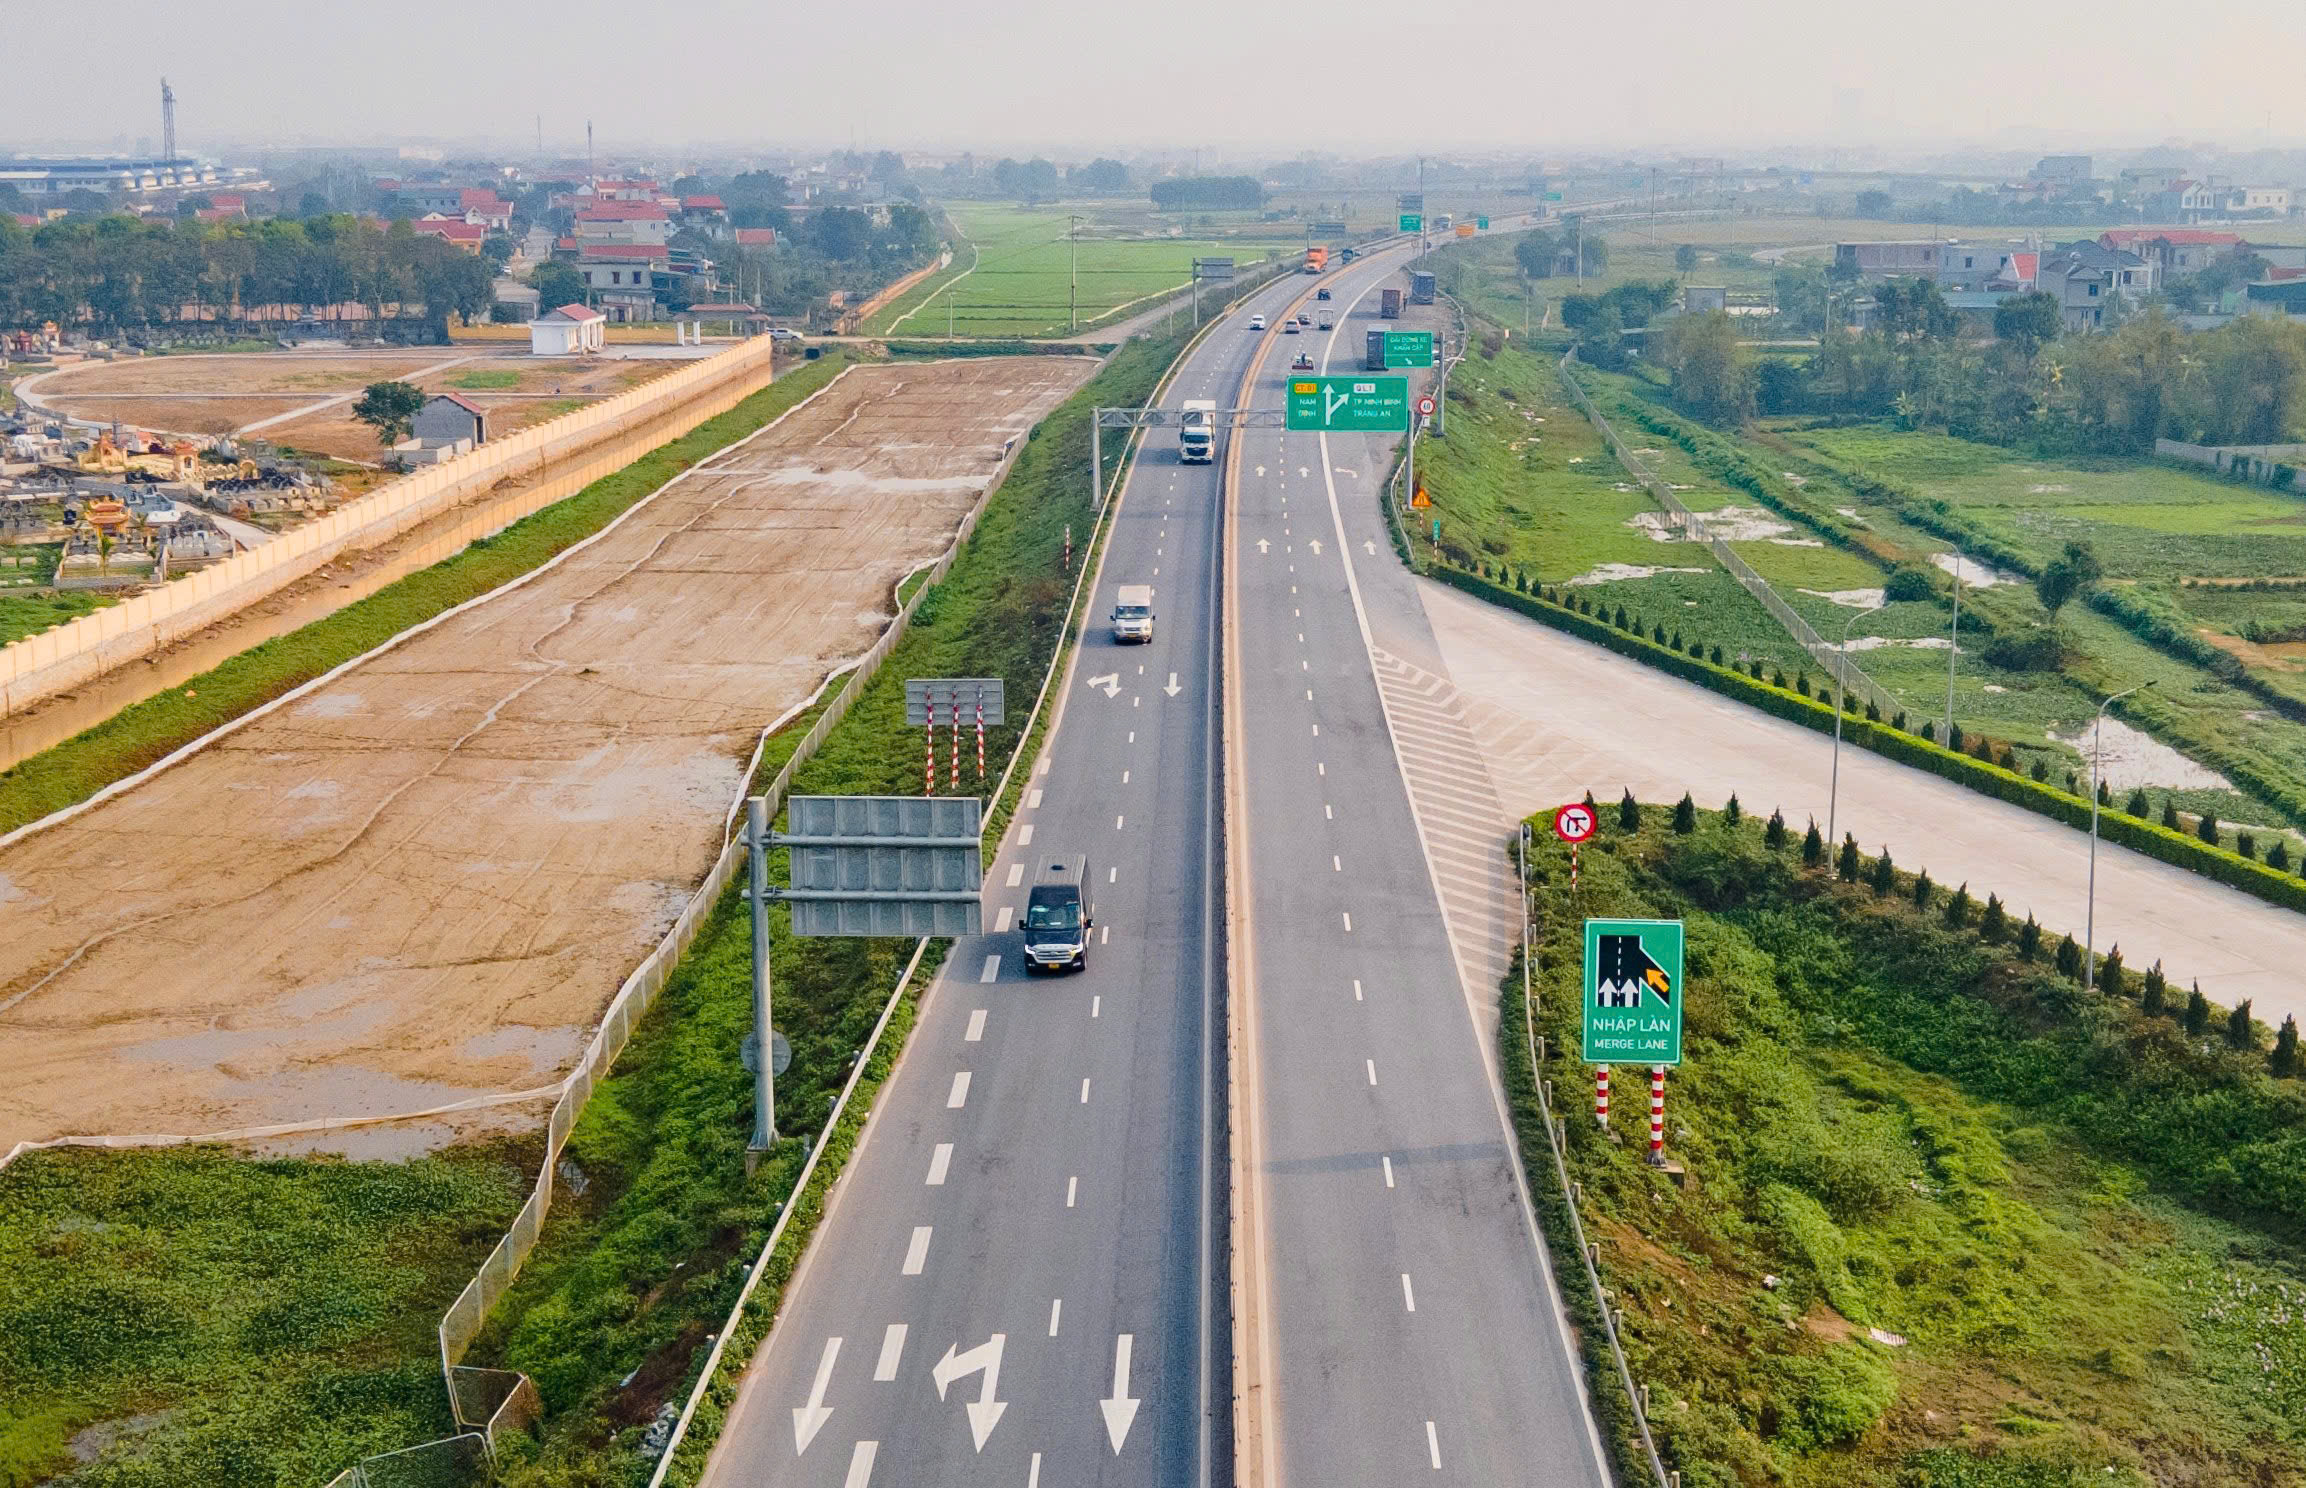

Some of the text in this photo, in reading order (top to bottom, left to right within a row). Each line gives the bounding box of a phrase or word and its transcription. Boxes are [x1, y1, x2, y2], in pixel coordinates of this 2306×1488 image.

[1380, 408, 1391, 417] AN
[1593, 1014, 1670, 1034] NHẬP LÀN
[1595, 1039, 1668, 1050] MERGE LANE
